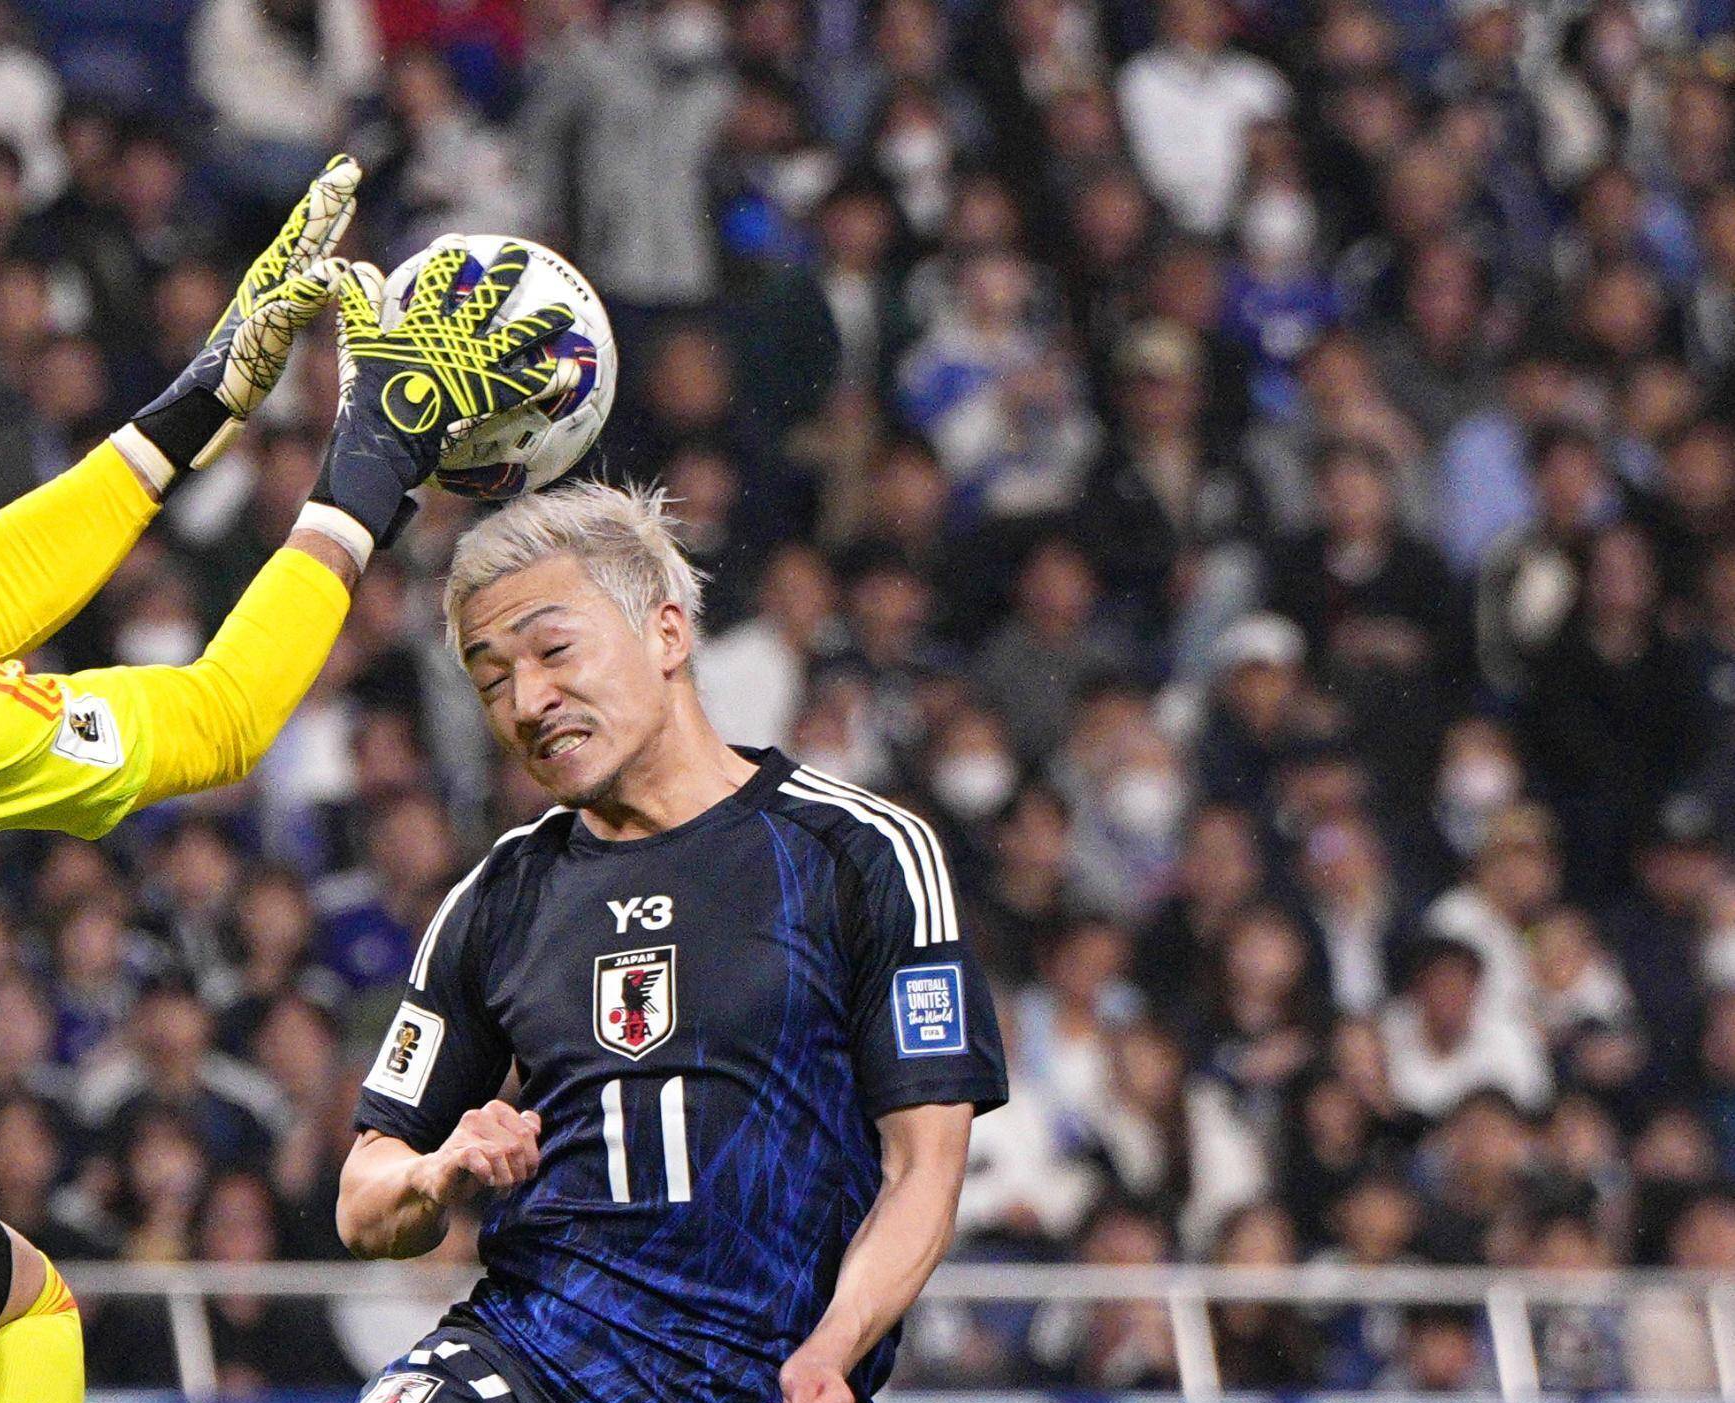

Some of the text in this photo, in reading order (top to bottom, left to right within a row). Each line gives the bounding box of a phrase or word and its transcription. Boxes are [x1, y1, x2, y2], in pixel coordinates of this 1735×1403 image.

[606, 895, 673, 934] Y-3
[614, 952, 657, 967] JAPAN
[906, 978, 948, 992] FOOTBALL
[907, 990, 949, 1010] UNITES
[907, 1007, 953, 1025] the World
[617, 1024, 653, 1041] JFA
[600, 1075, 691, 1203] 11
